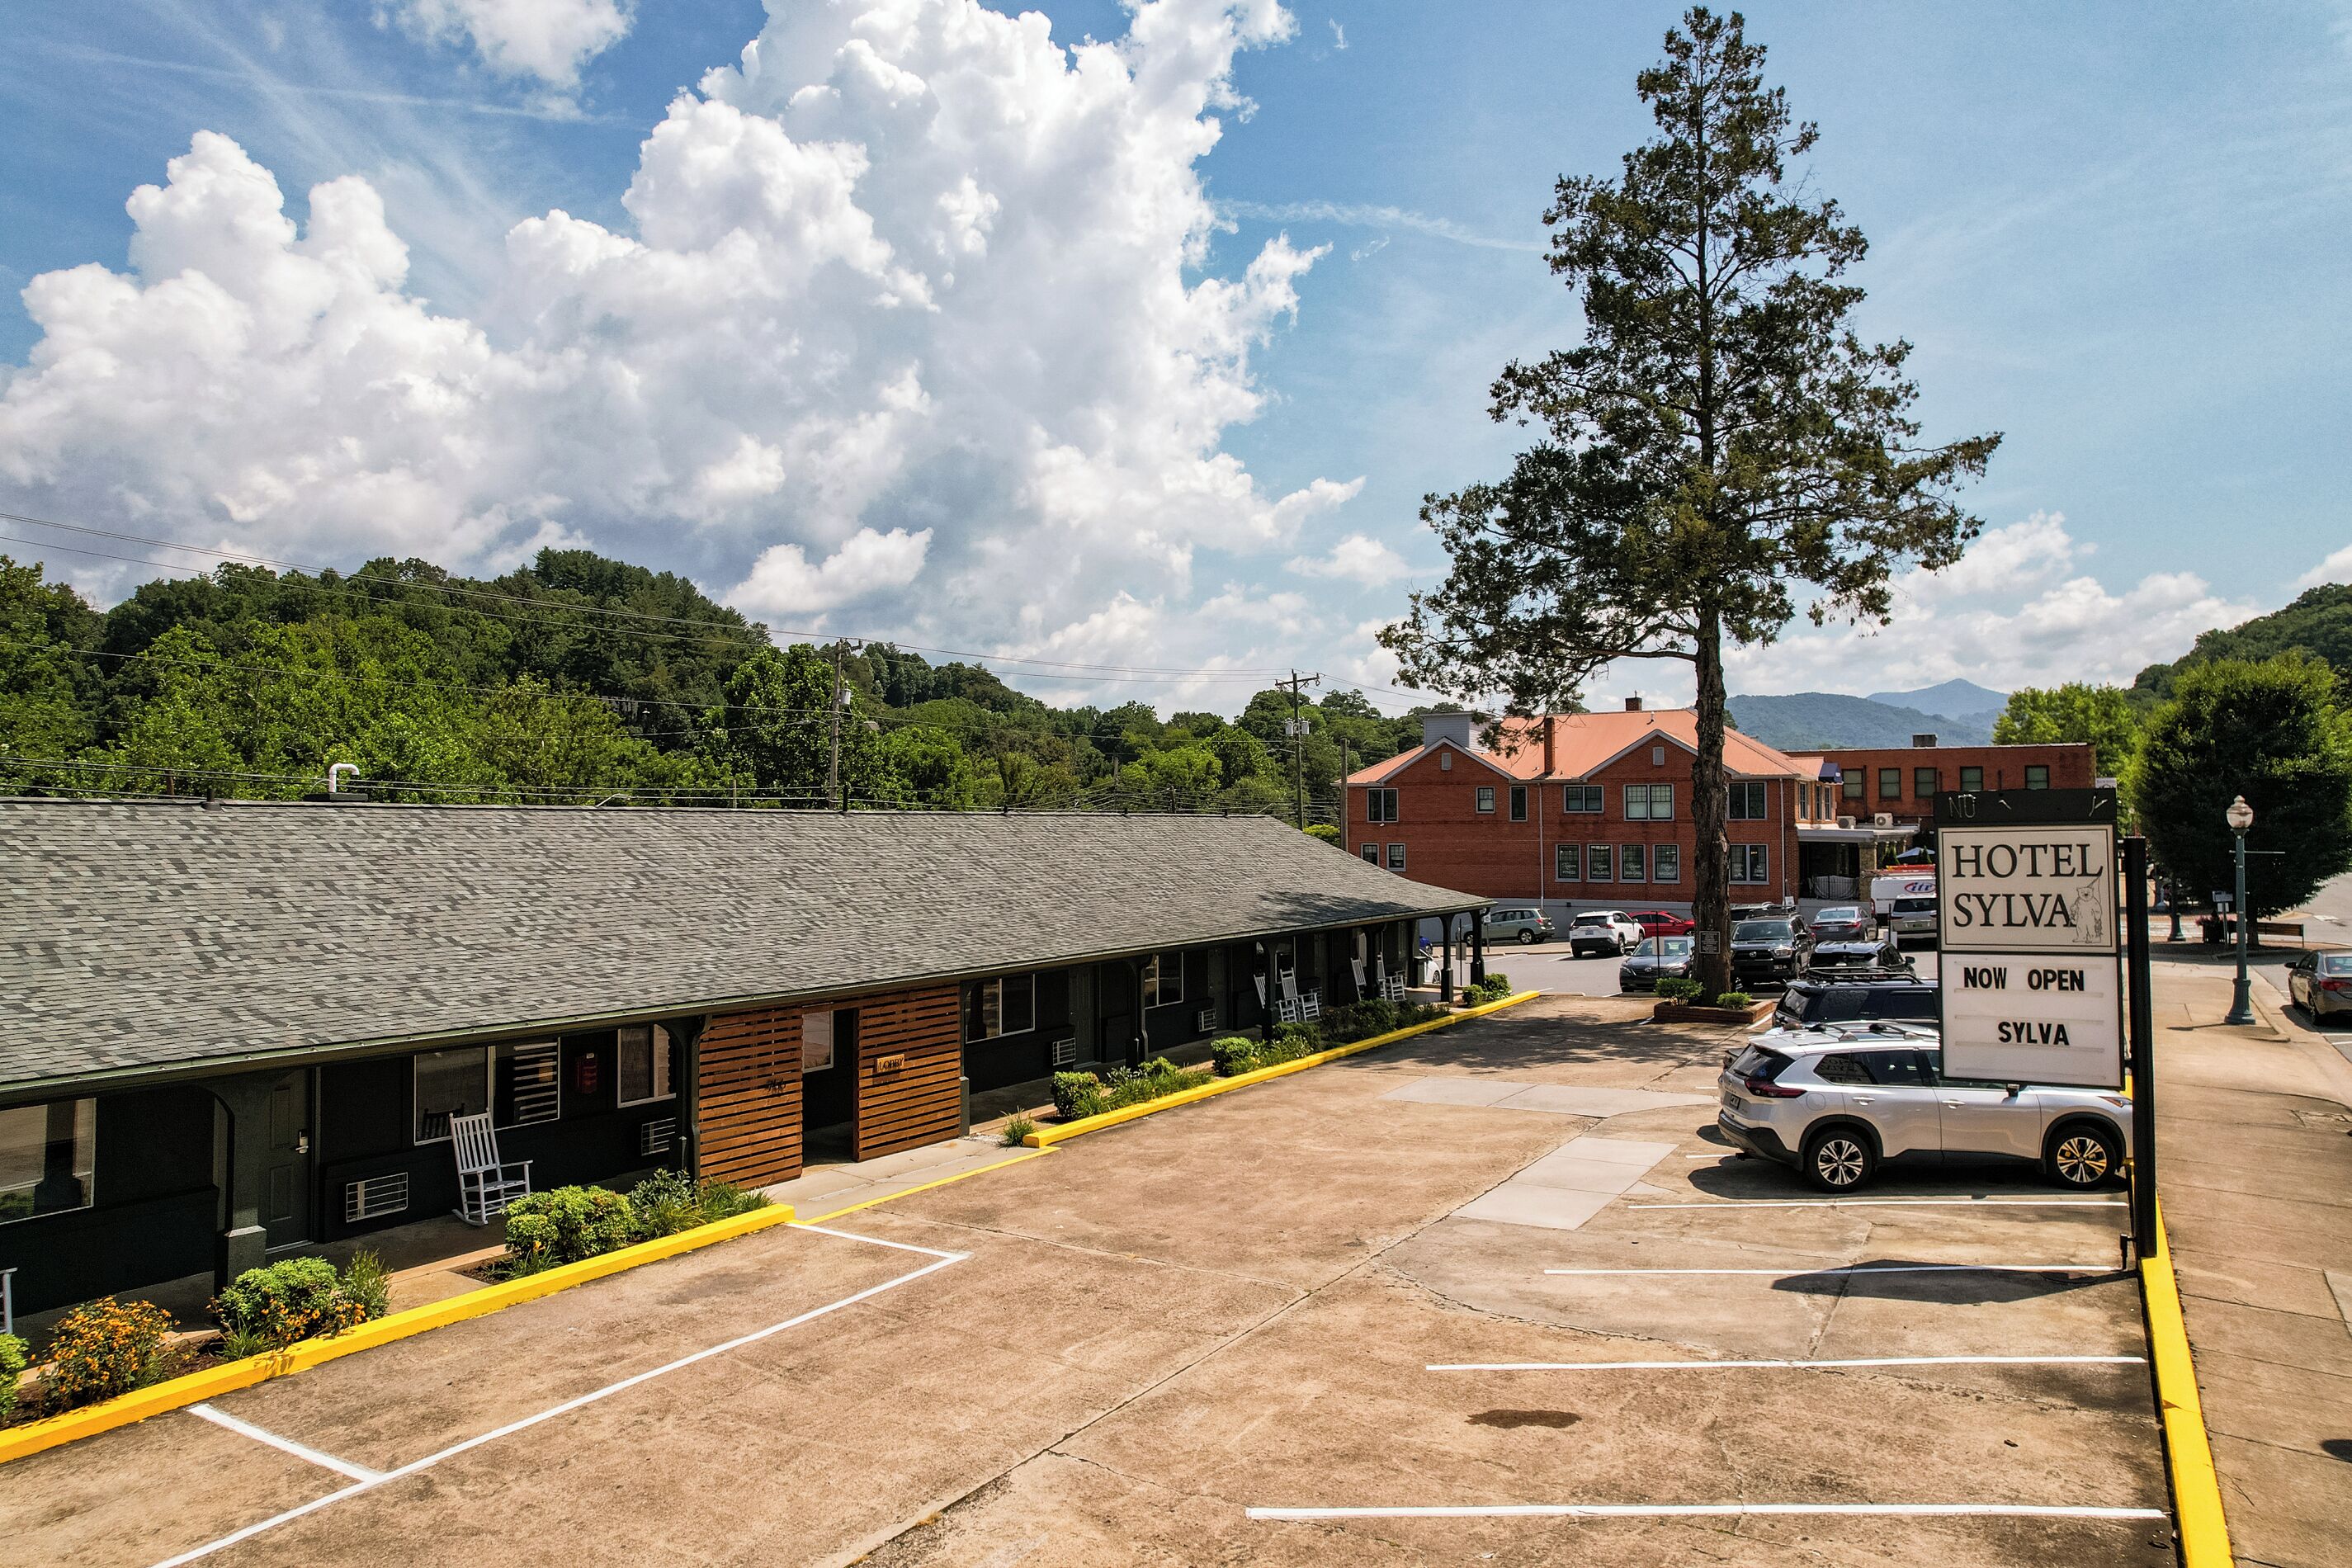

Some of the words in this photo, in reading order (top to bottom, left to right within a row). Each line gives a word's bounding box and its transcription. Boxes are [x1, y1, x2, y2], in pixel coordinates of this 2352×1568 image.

[1951, 843, 2104, 879] HOTEL
[1953, 892, 2077, 928] SYLVA
[1963, 966, 2007, 989] NOW
[2028, 969, 2085, 992] OPEN
[1998, 1021, 2070, 1046] SYLVA
[879, 1057, 904, 1071] LOBBY
